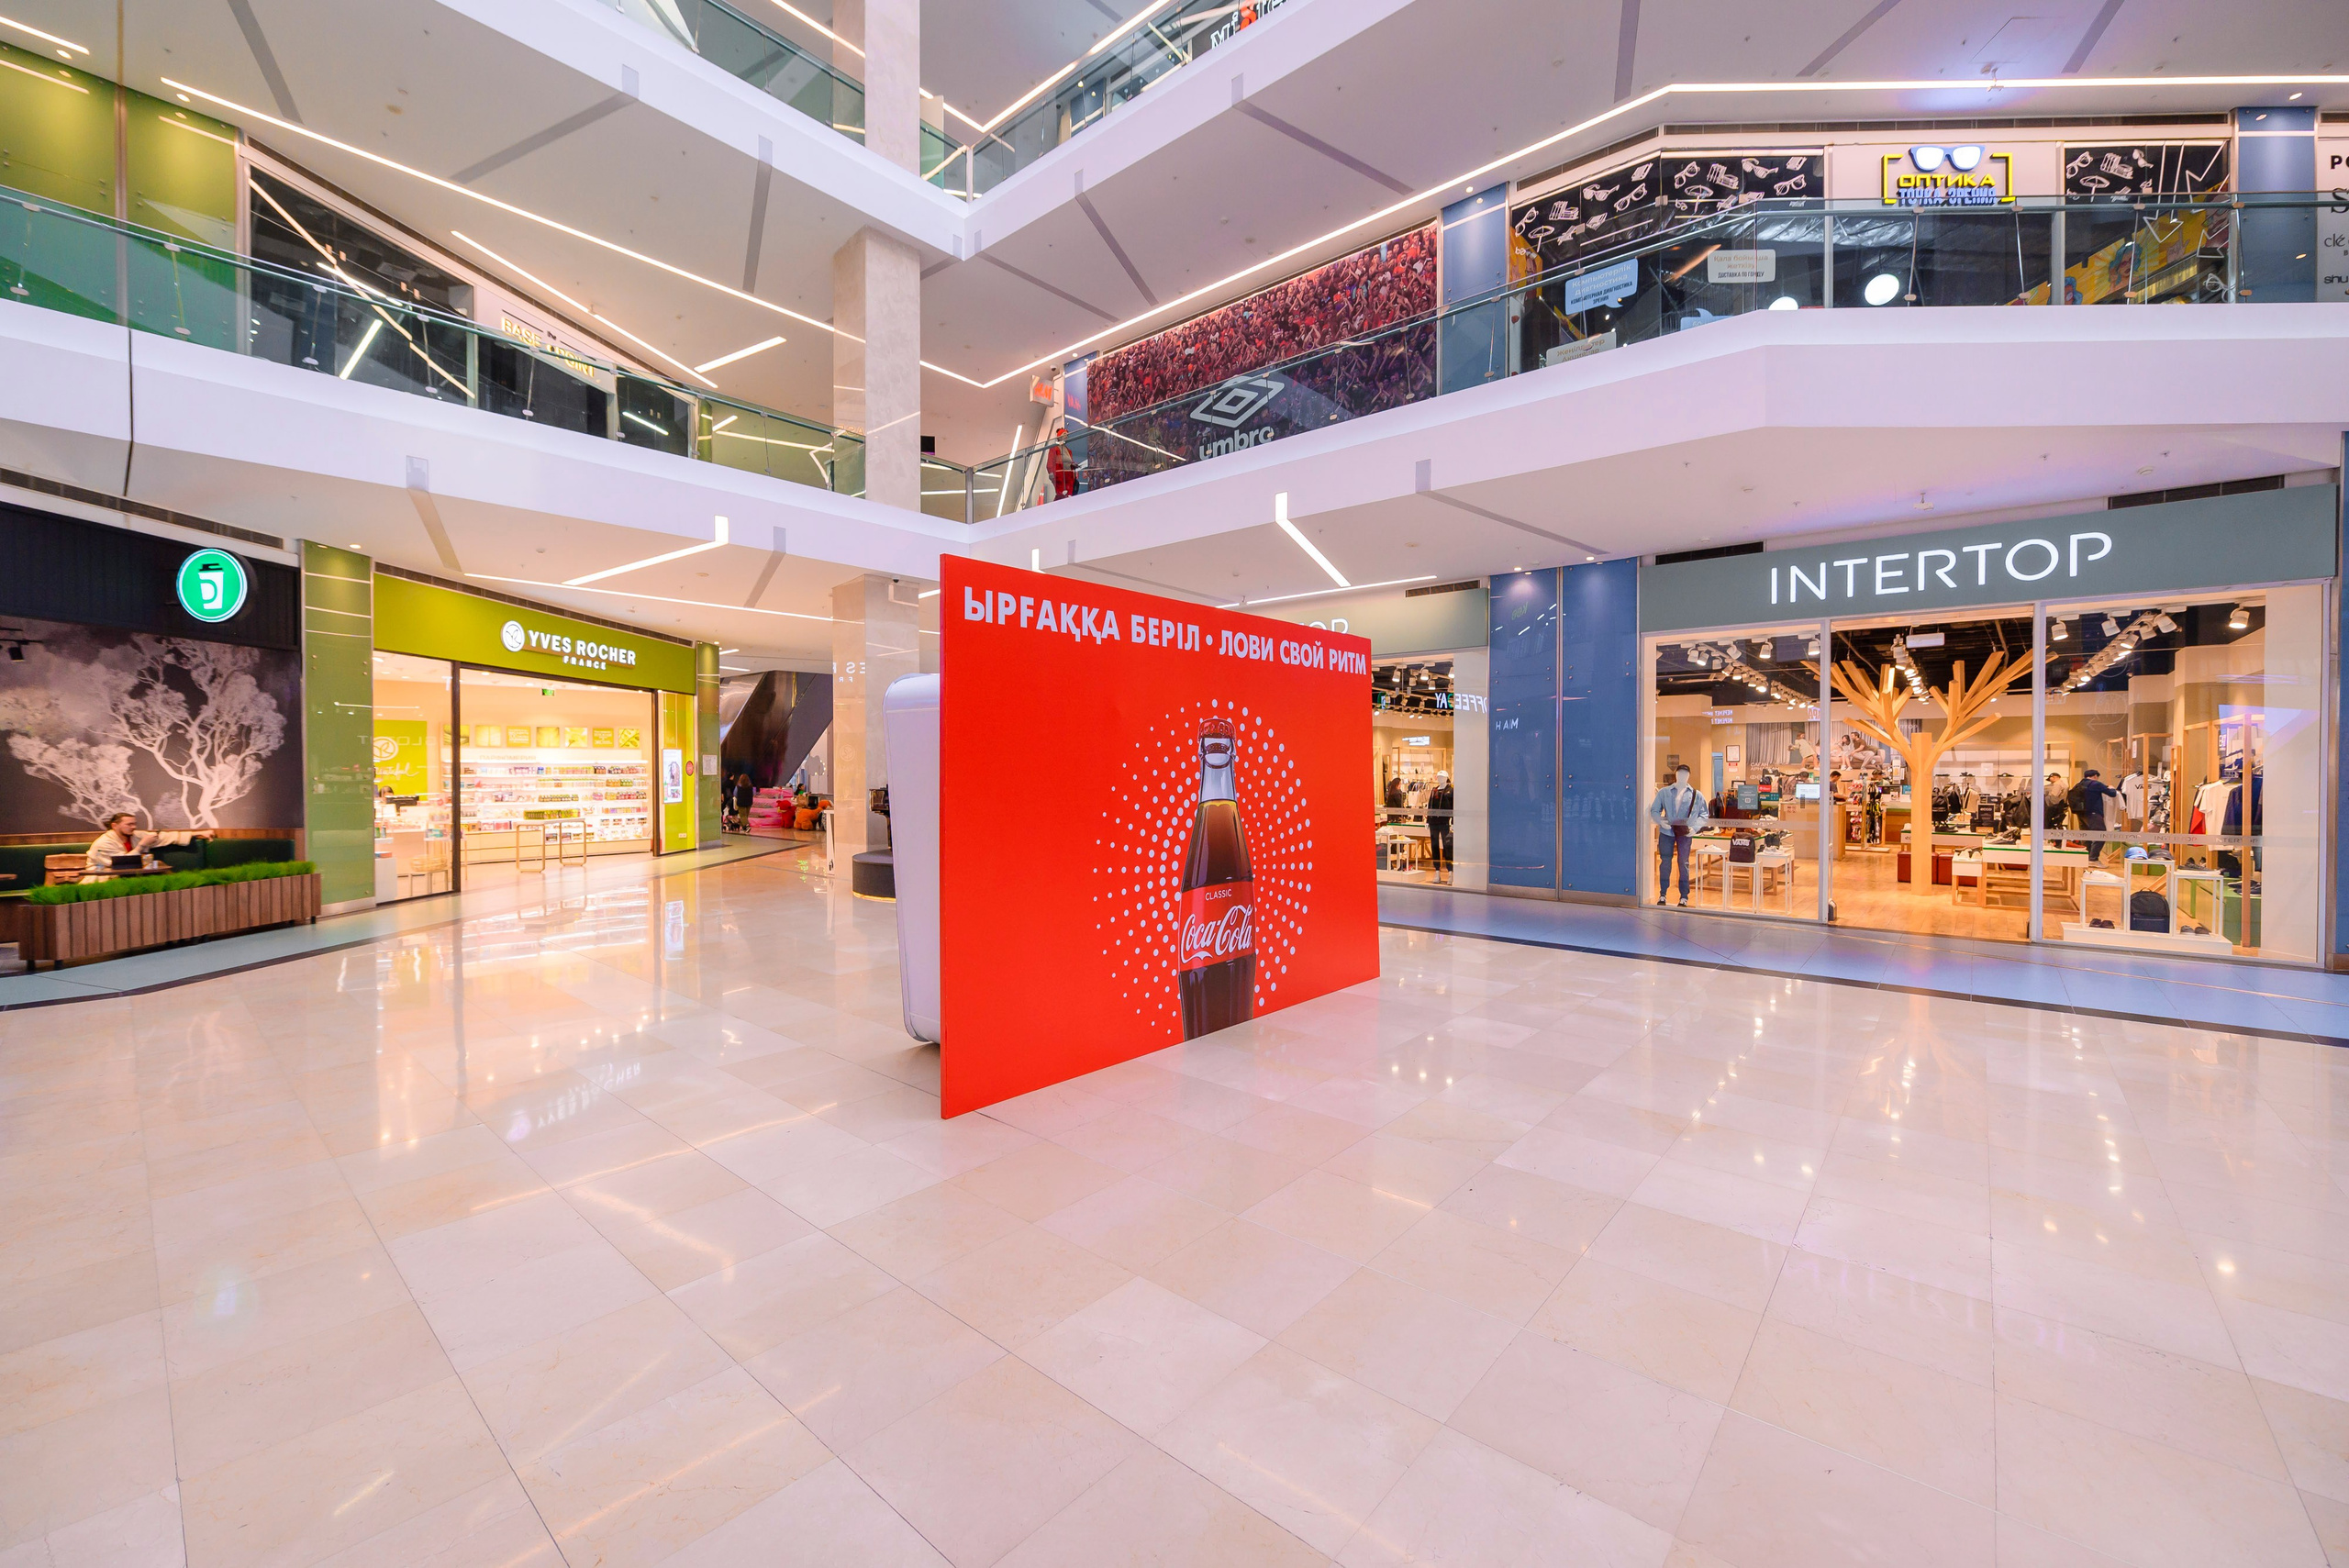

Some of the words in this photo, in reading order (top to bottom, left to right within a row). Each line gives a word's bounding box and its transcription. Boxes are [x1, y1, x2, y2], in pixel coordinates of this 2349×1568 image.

[1897, 188, 1943, 206] ТОЧКА
[1948, 188, 1998, 206] ЗРЕНИЯ
[1898, 172, 1997, 188] ОПТИКА
[1199, 426, 1274, 461] umbro
[1770, 531, 2113, 606] INTERTOP
[528, 630, 572, 653] YVES
[575, 639, 636, 665] ROCHER
[964, 585, 1120, 645] ЫРҒАҚҚА
[1130, 614, 1200, 652] БЕРІЛ
[1219, 629, 1275, 662] ЛОВИ
[1279, 640, 1324, 670] СВОЙ
[1329, 649, 1367, 675] РИТМ
[562, 655, 607, 670] FRANCE
[1205, 888, 1232, 901] CLASSIC
[1180, 904, 1253, 964] Coca-Cola
